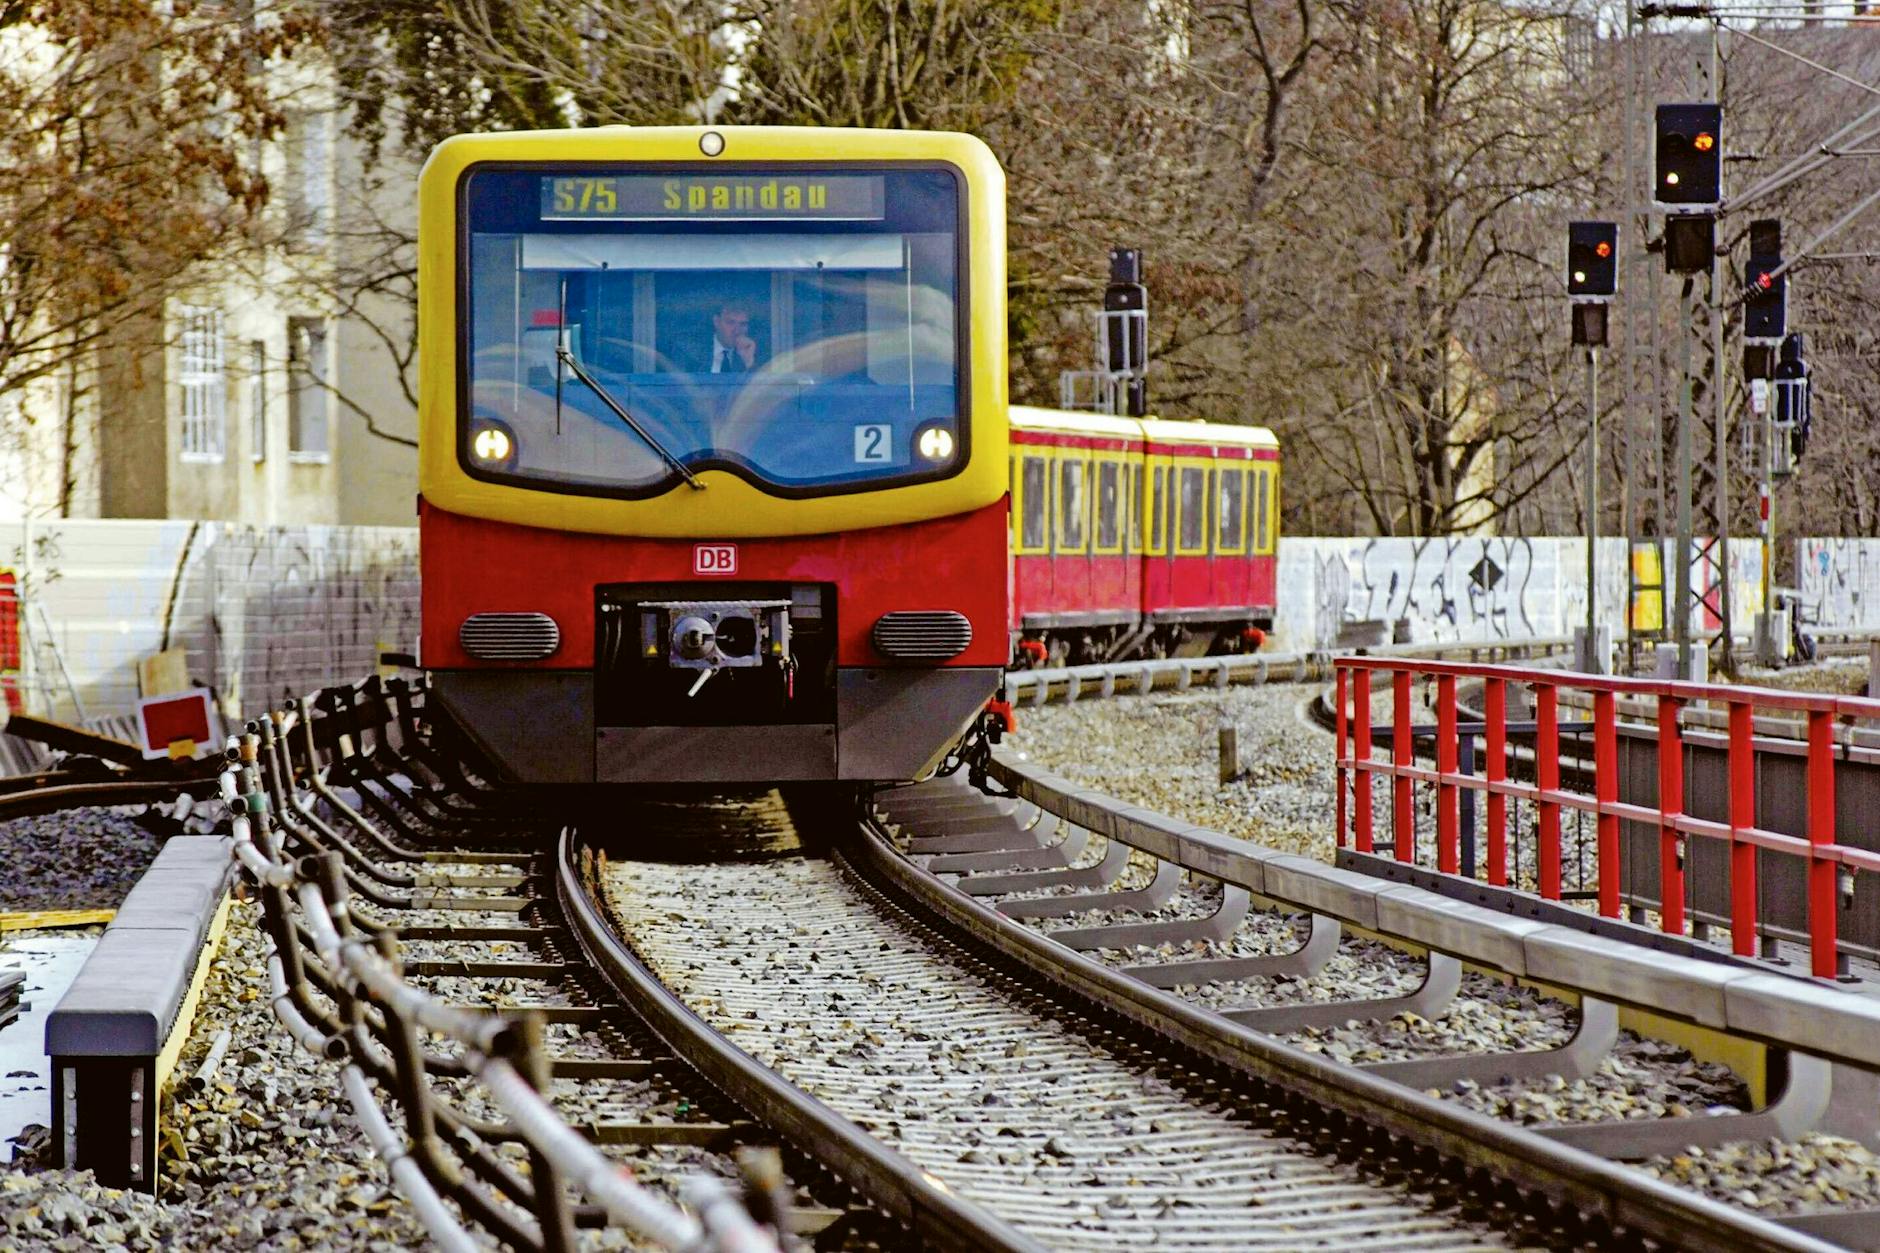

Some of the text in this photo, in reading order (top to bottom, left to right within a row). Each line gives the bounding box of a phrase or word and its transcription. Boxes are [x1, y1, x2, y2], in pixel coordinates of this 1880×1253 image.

[554, 177, 826, 213] S75 Spandau
[864, 426, 883, 459] 2
[700, 549, 732, 569] DB
